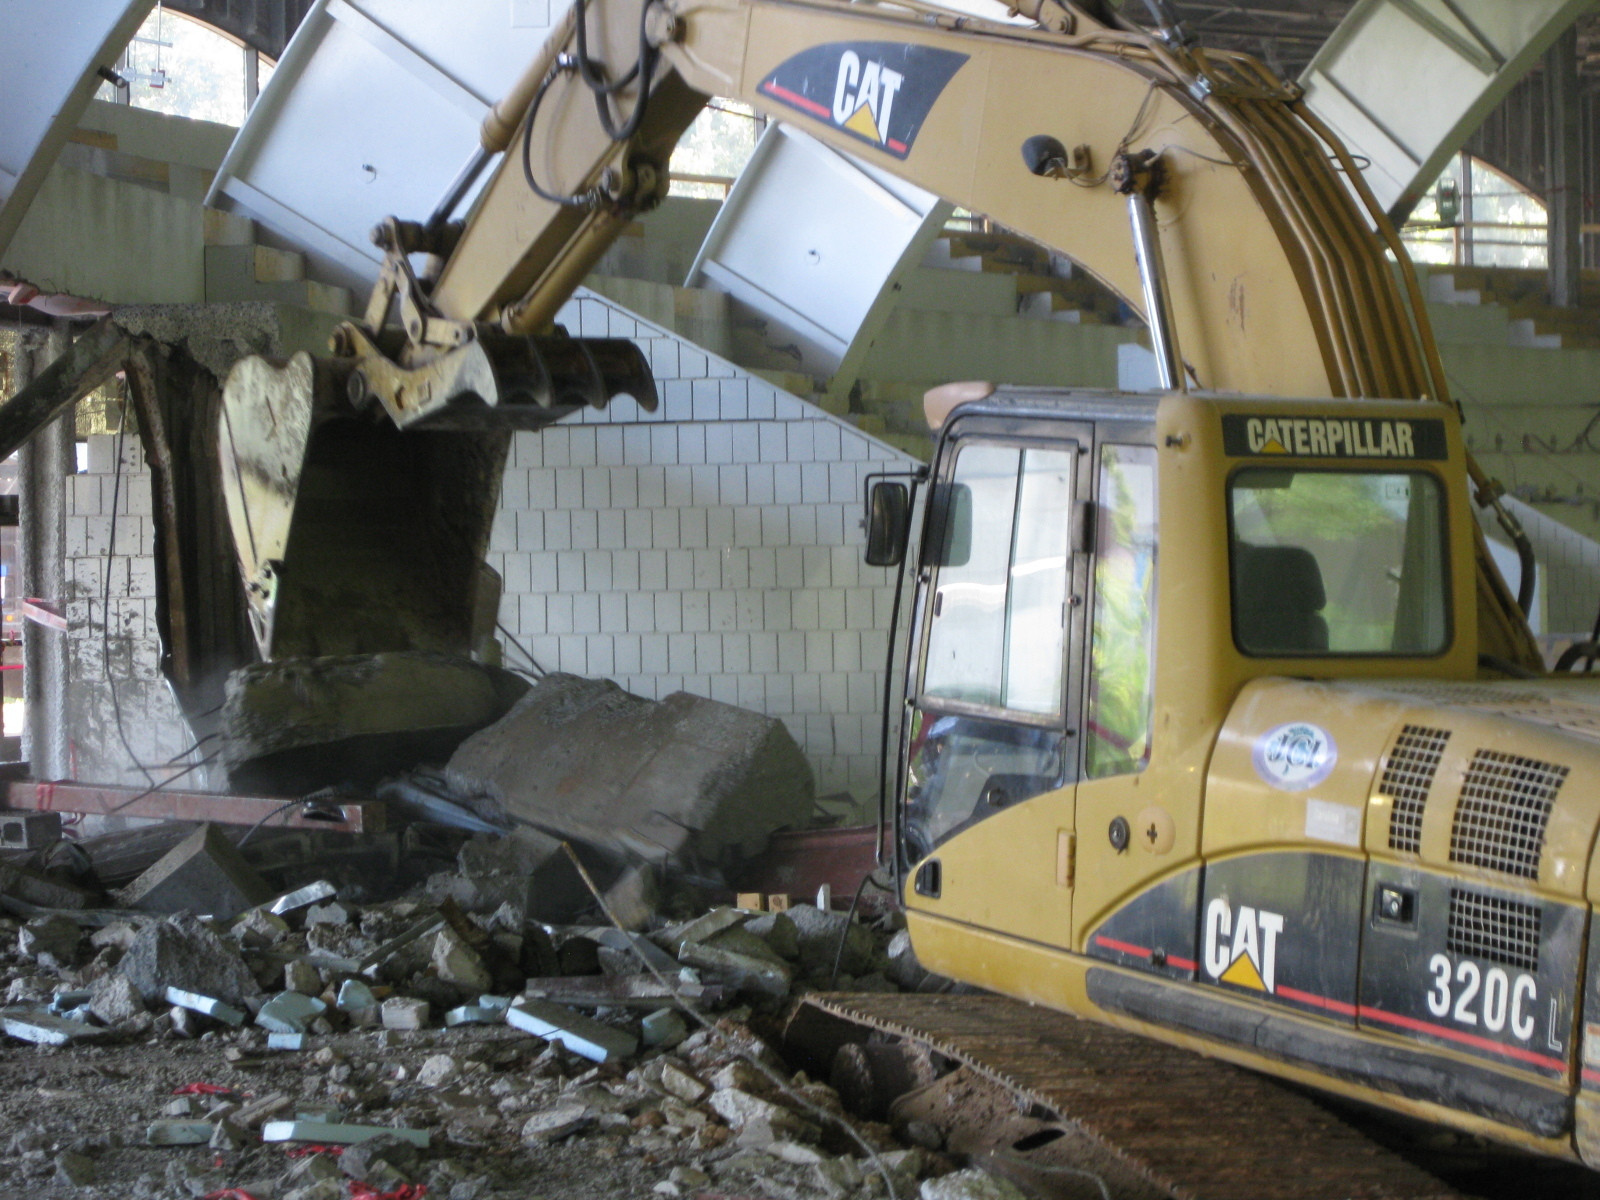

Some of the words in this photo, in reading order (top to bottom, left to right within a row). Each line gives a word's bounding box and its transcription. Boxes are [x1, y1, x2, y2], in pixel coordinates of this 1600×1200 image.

[833, 50, 902, 145] CAT
[1247, 418, 1415, 457] CATERPILLAR
[1205, 898, 1284, 995] CAT
[1427, 953, 1537, 1041] 320C
